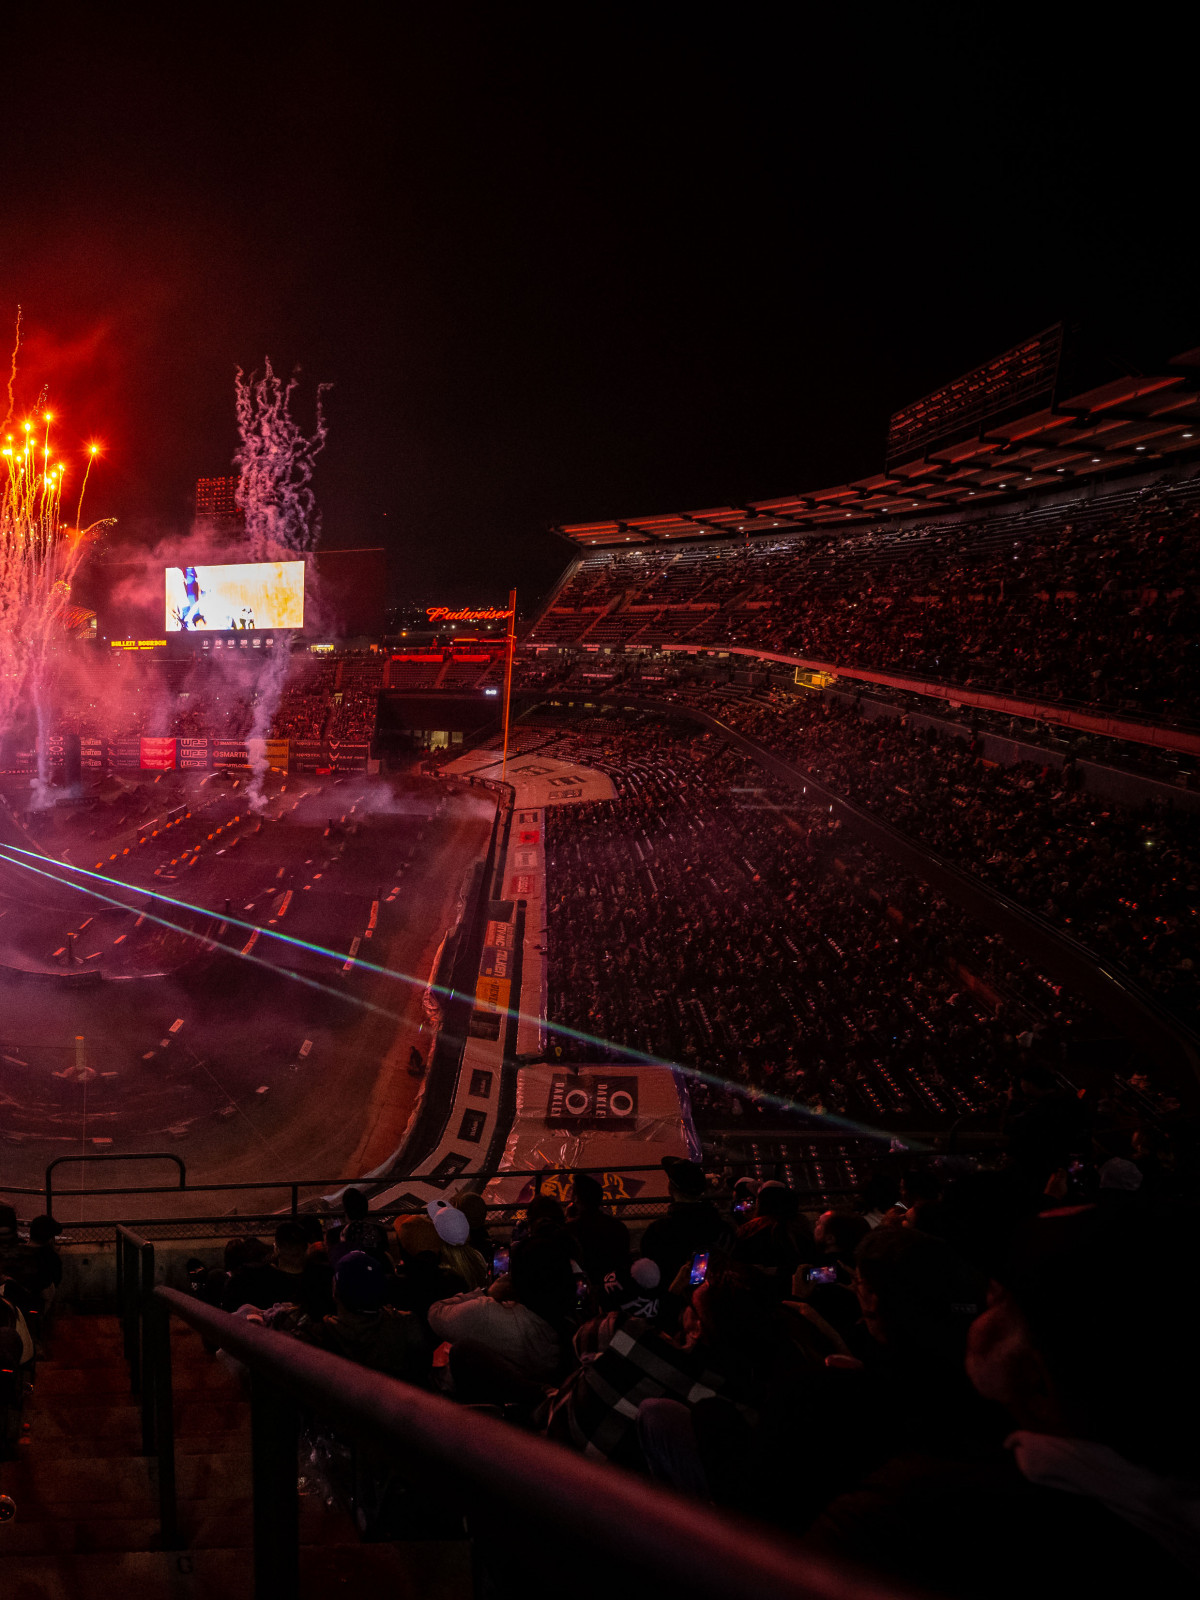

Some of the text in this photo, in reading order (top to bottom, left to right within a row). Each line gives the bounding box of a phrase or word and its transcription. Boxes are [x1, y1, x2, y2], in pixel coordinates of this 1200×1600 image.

[426, 606, 514, 623] Budweiser
[180, 749, 208, 758] WPS
[493, 949, 508, 977] FALKEN
[177, 1556, 193, 1574] G
